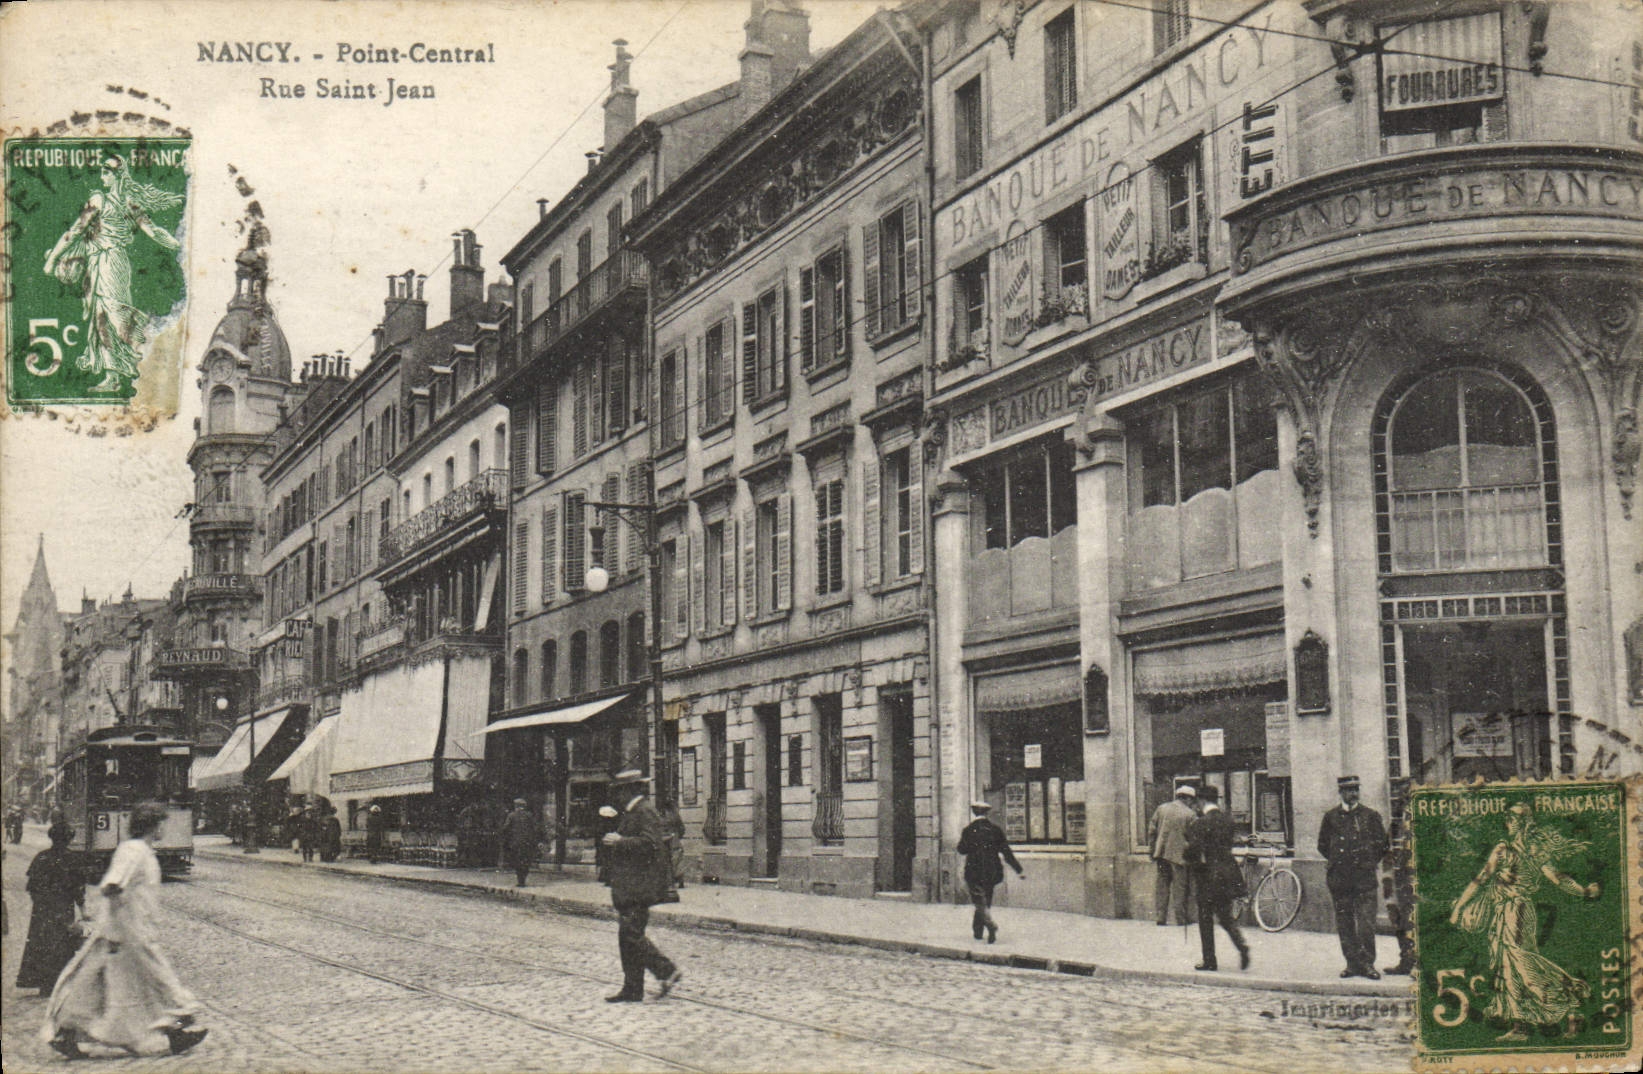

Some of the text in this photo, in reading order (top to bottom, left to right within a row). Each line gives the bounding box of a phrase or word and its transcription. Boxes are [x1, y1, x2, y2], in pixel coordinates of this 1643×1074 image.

[1385, 66, 1498, 106] FOURRURES
[951, 11, 1275, 248] BANQUE DE NANCY
[13, 148, 104, 168] REPUBLIQUE
[1103, 178, 1133, 213] PETIT
[1267, 171, 1643, 249] BANQUE DE NANCY
[1104, 207, 1136, 260] TAILLEUR
[1105, 258, 1139, 291] DAMES
[1098, 374, 1114, 394] DE
[1117, 325, 1203, 389] NANCY
[162, 650, 222, 663] REYNAUD
[96, 815, 107, 829] 5
[1601, 947, 1622, 1034] POSTES
